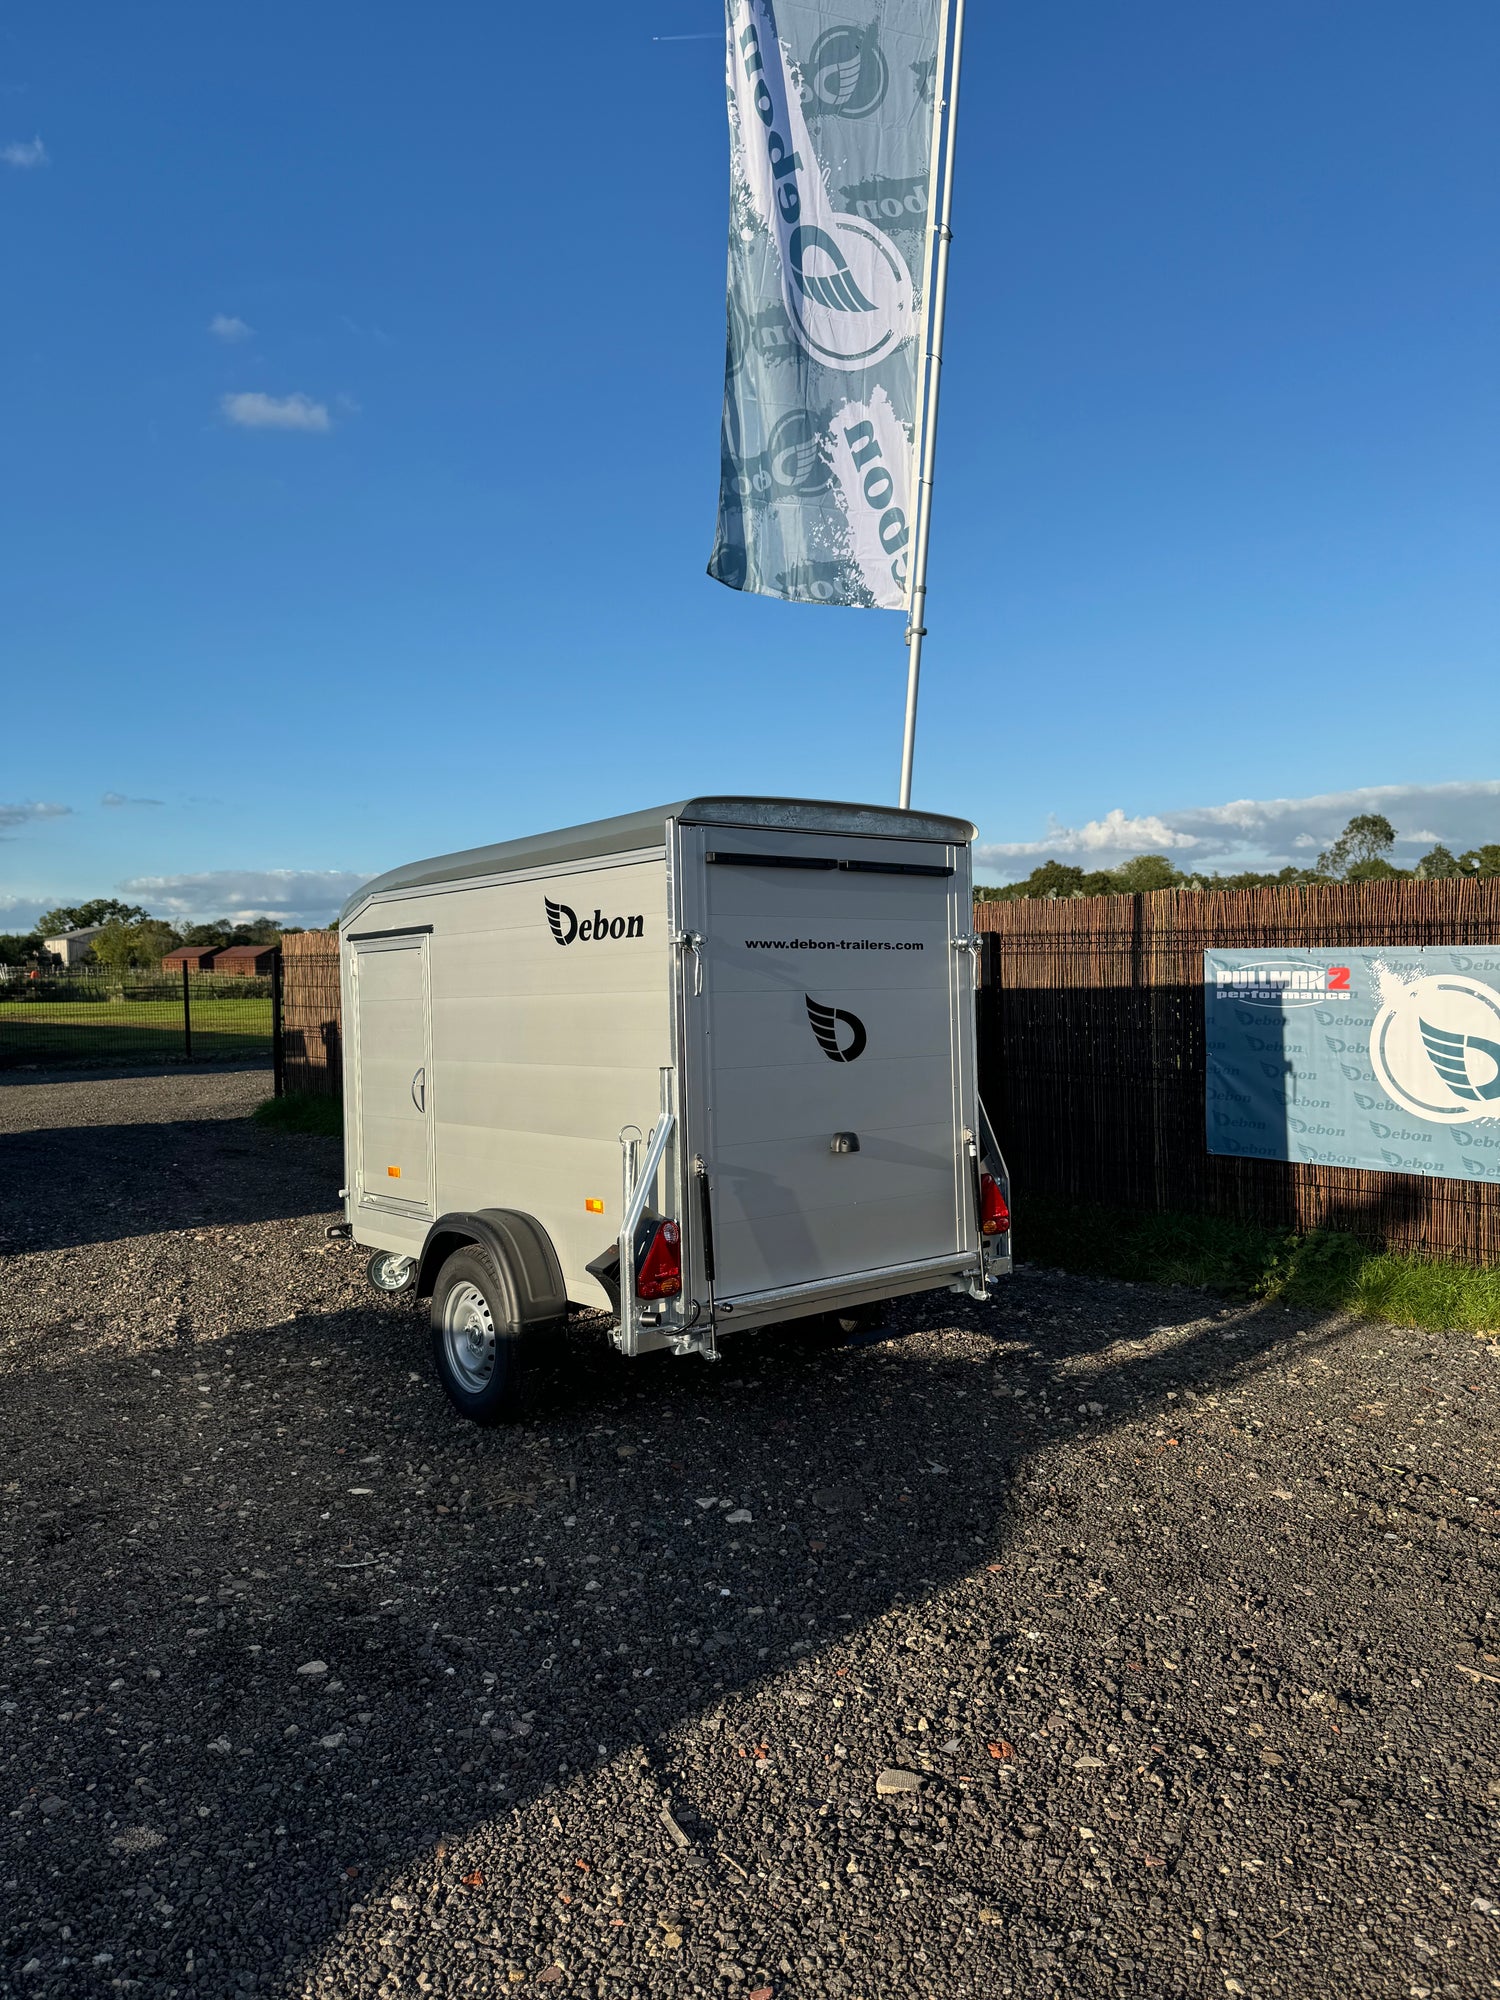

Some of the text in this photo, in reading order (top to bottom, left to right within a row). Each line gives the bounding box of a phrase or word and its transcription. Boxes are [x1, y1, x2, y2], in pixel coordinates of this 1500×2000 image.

[544, 895, 645, 946] Debon
[744, 938, 925, 951] www.debon-trailers.com
[1449, 952, 1500, 972] Debo
[1327, 967, 1351, 990] 2
[1216, 990, 1351, 1000] performance
[1341, 1062, 1379, 1082] Deb
[1354, 1091, 1404, 1112] Debo
[1213, 1109, 1267, 1131] Debon
[1287, 1116, 1346, 1137] Debon
[1369, 1119, 1433, 1143] Debon
[1449, 1126, 1500, 1149] Debo
[1298, 1142, 1357, 1165] Debon
[1381, 1147, 1445, 1171] Debon
